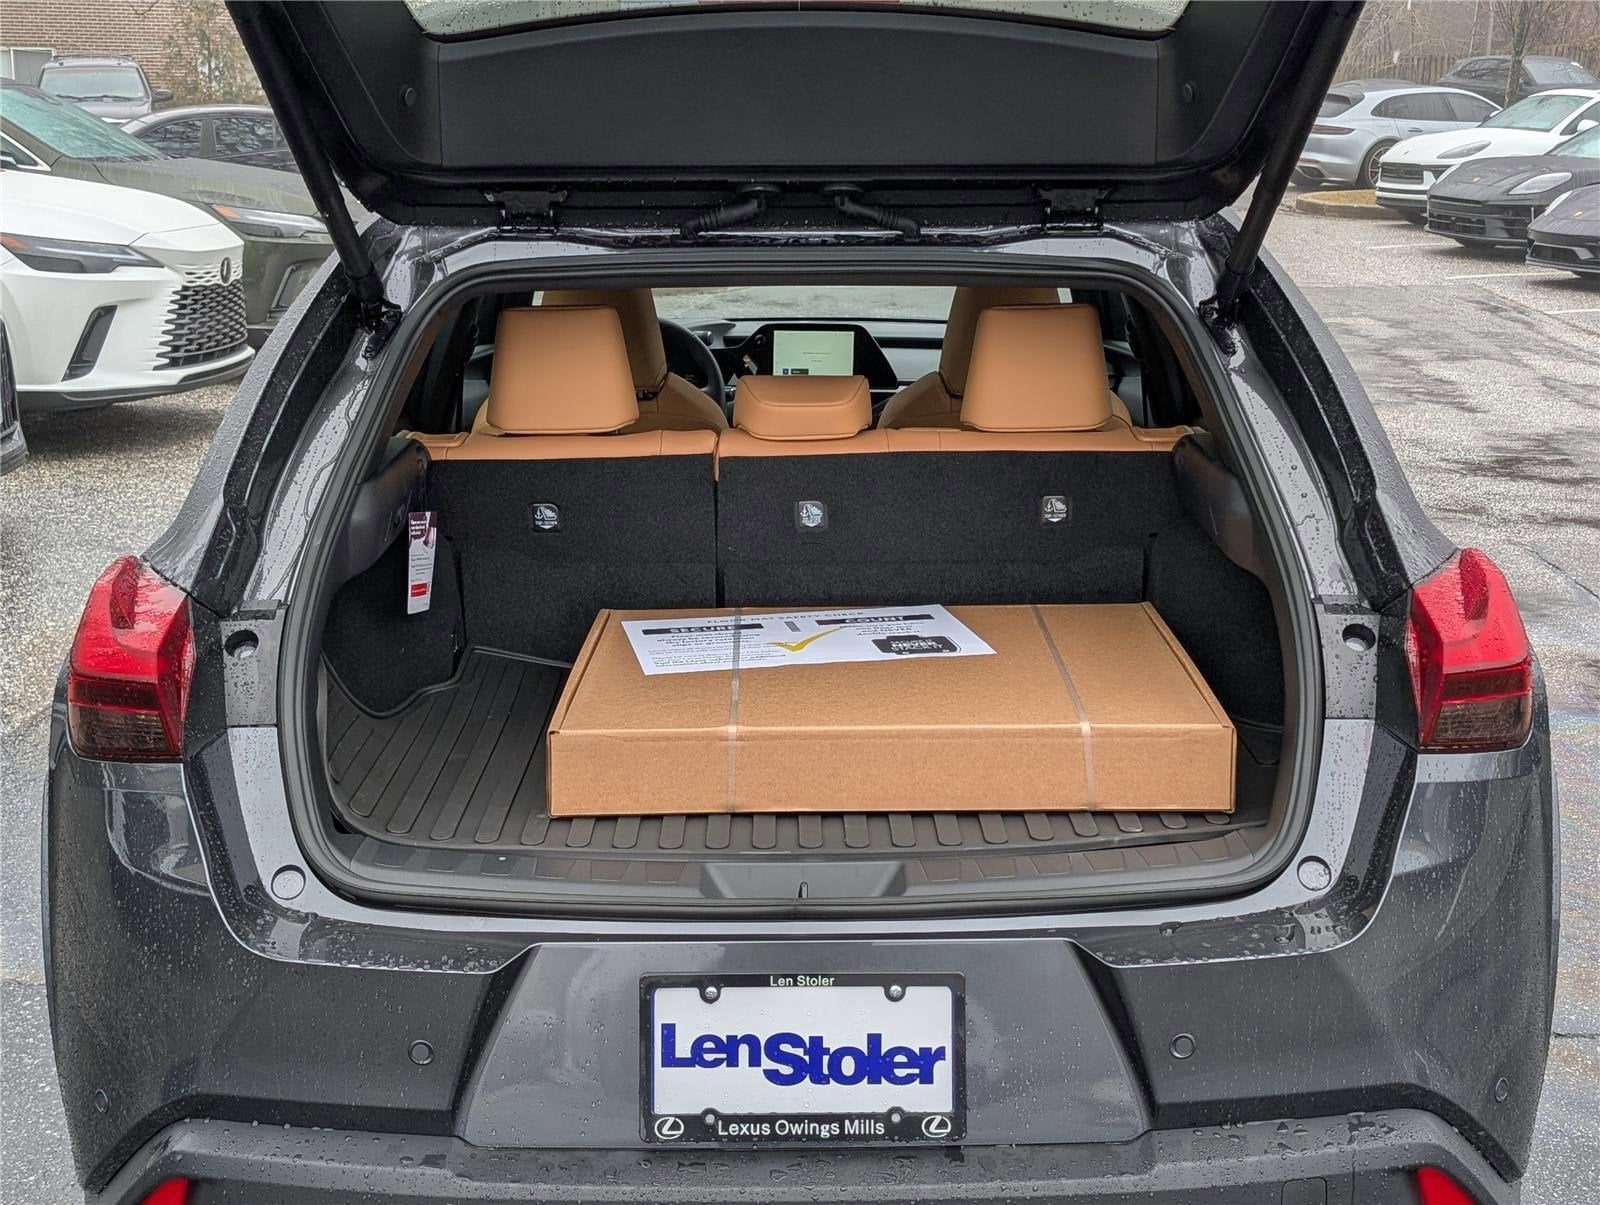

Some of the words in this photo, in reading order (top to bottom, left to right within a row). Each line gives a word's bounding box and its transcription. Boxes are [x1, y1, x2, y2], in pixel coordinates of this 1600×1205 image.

[770, 975, 794, 987] Len
[797, 975, 835, 987] Stoler
[717, 1119, 770, 1136] Lexus
[775, 1118, 840, 1137] Owings
[844, 1118, 885, 1135] Mills
